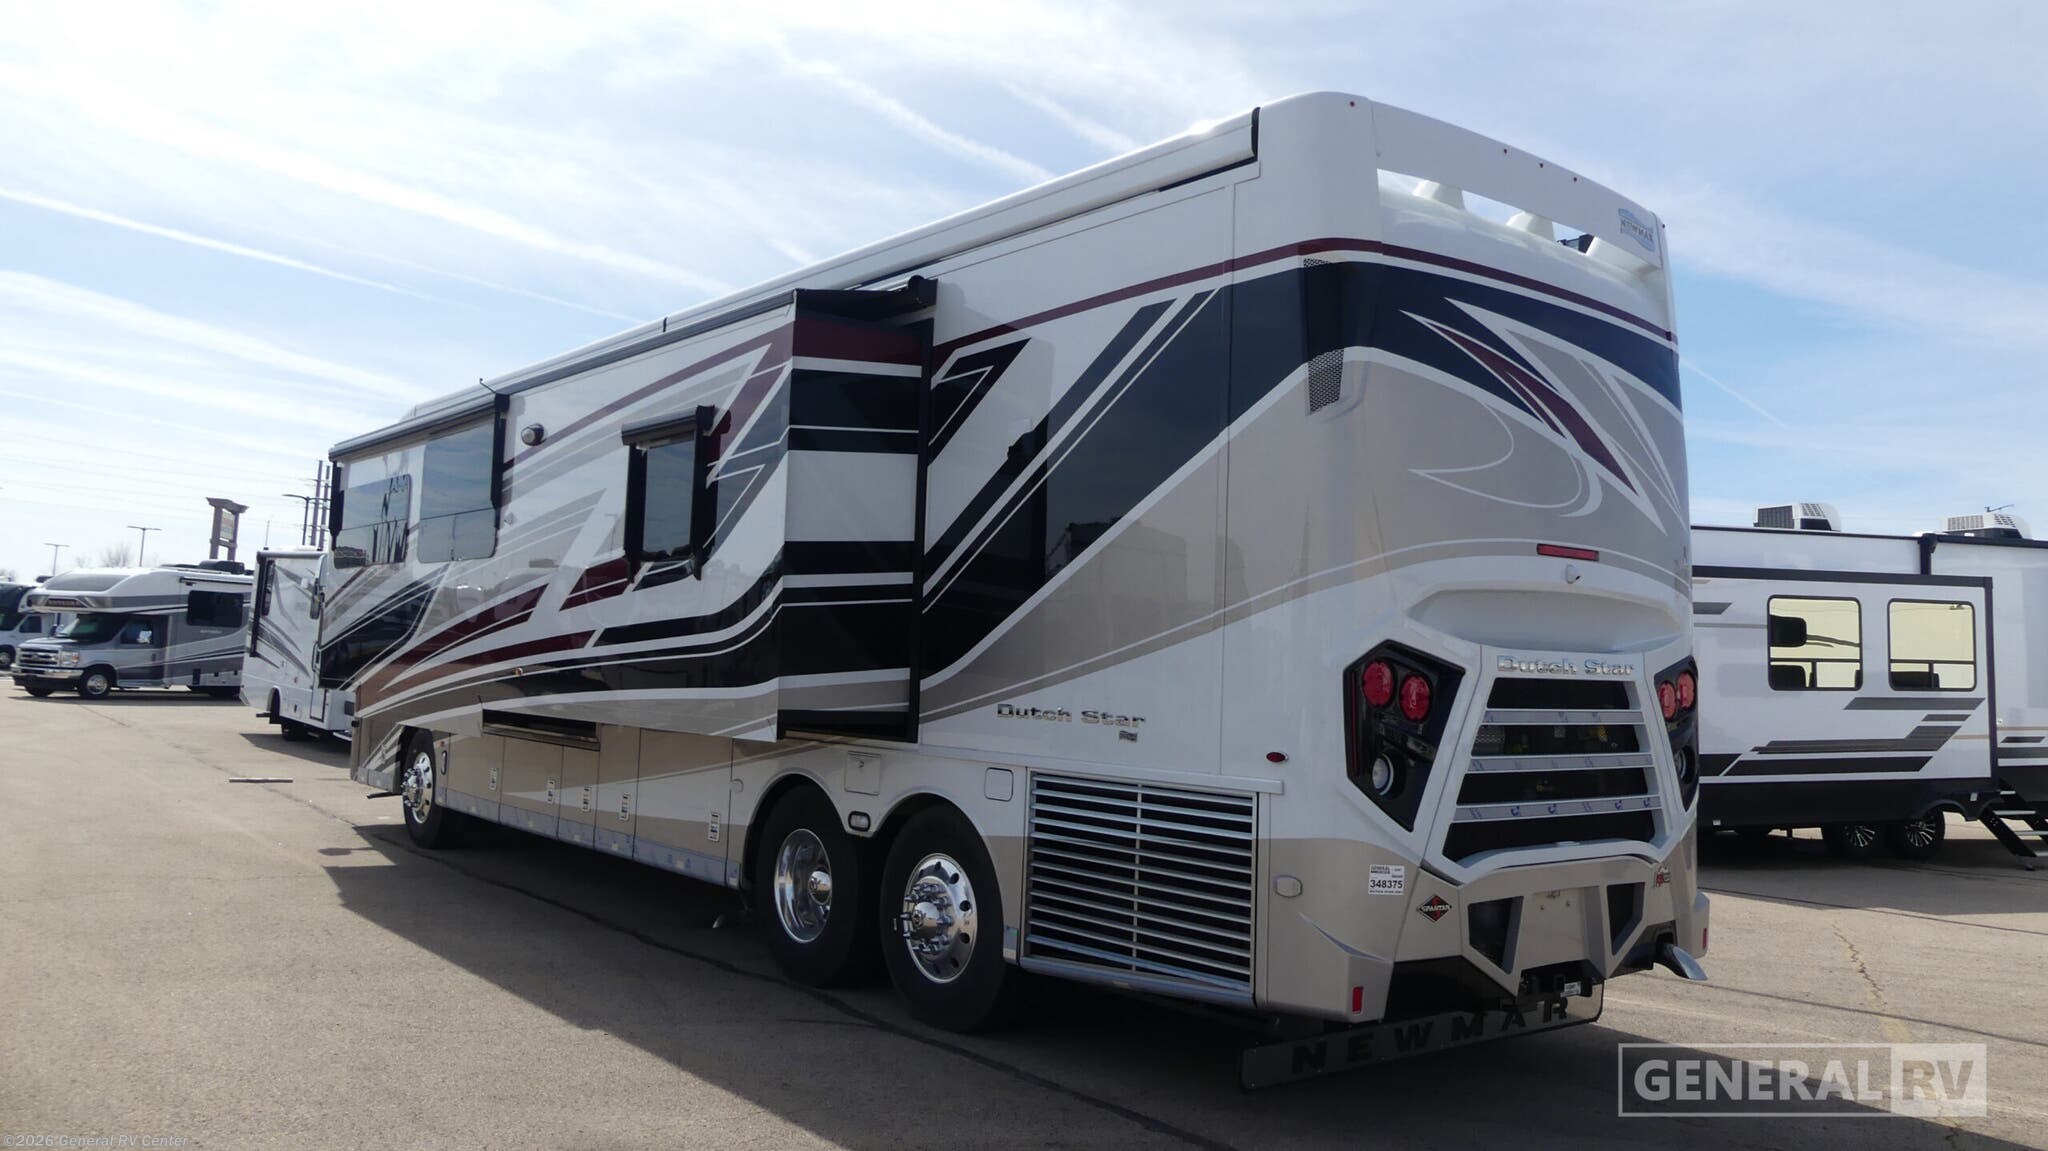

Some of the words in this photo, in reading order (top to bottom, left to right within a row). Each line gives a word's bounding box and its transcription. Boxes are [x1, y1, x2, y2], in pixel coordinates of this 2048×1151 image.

[1497, 655, 1577, 674] Dutch
[1584, 658, 1634, 676] Star
[997, 703, 1073, 722] Dutch
[1081, 709, 1146, 728] Star
[1370, 880, 1403, 888] 348375
[1421, 904, 1450, 912] SPARTAN
[1292, 998, 1568, 1074] NEWMAR
